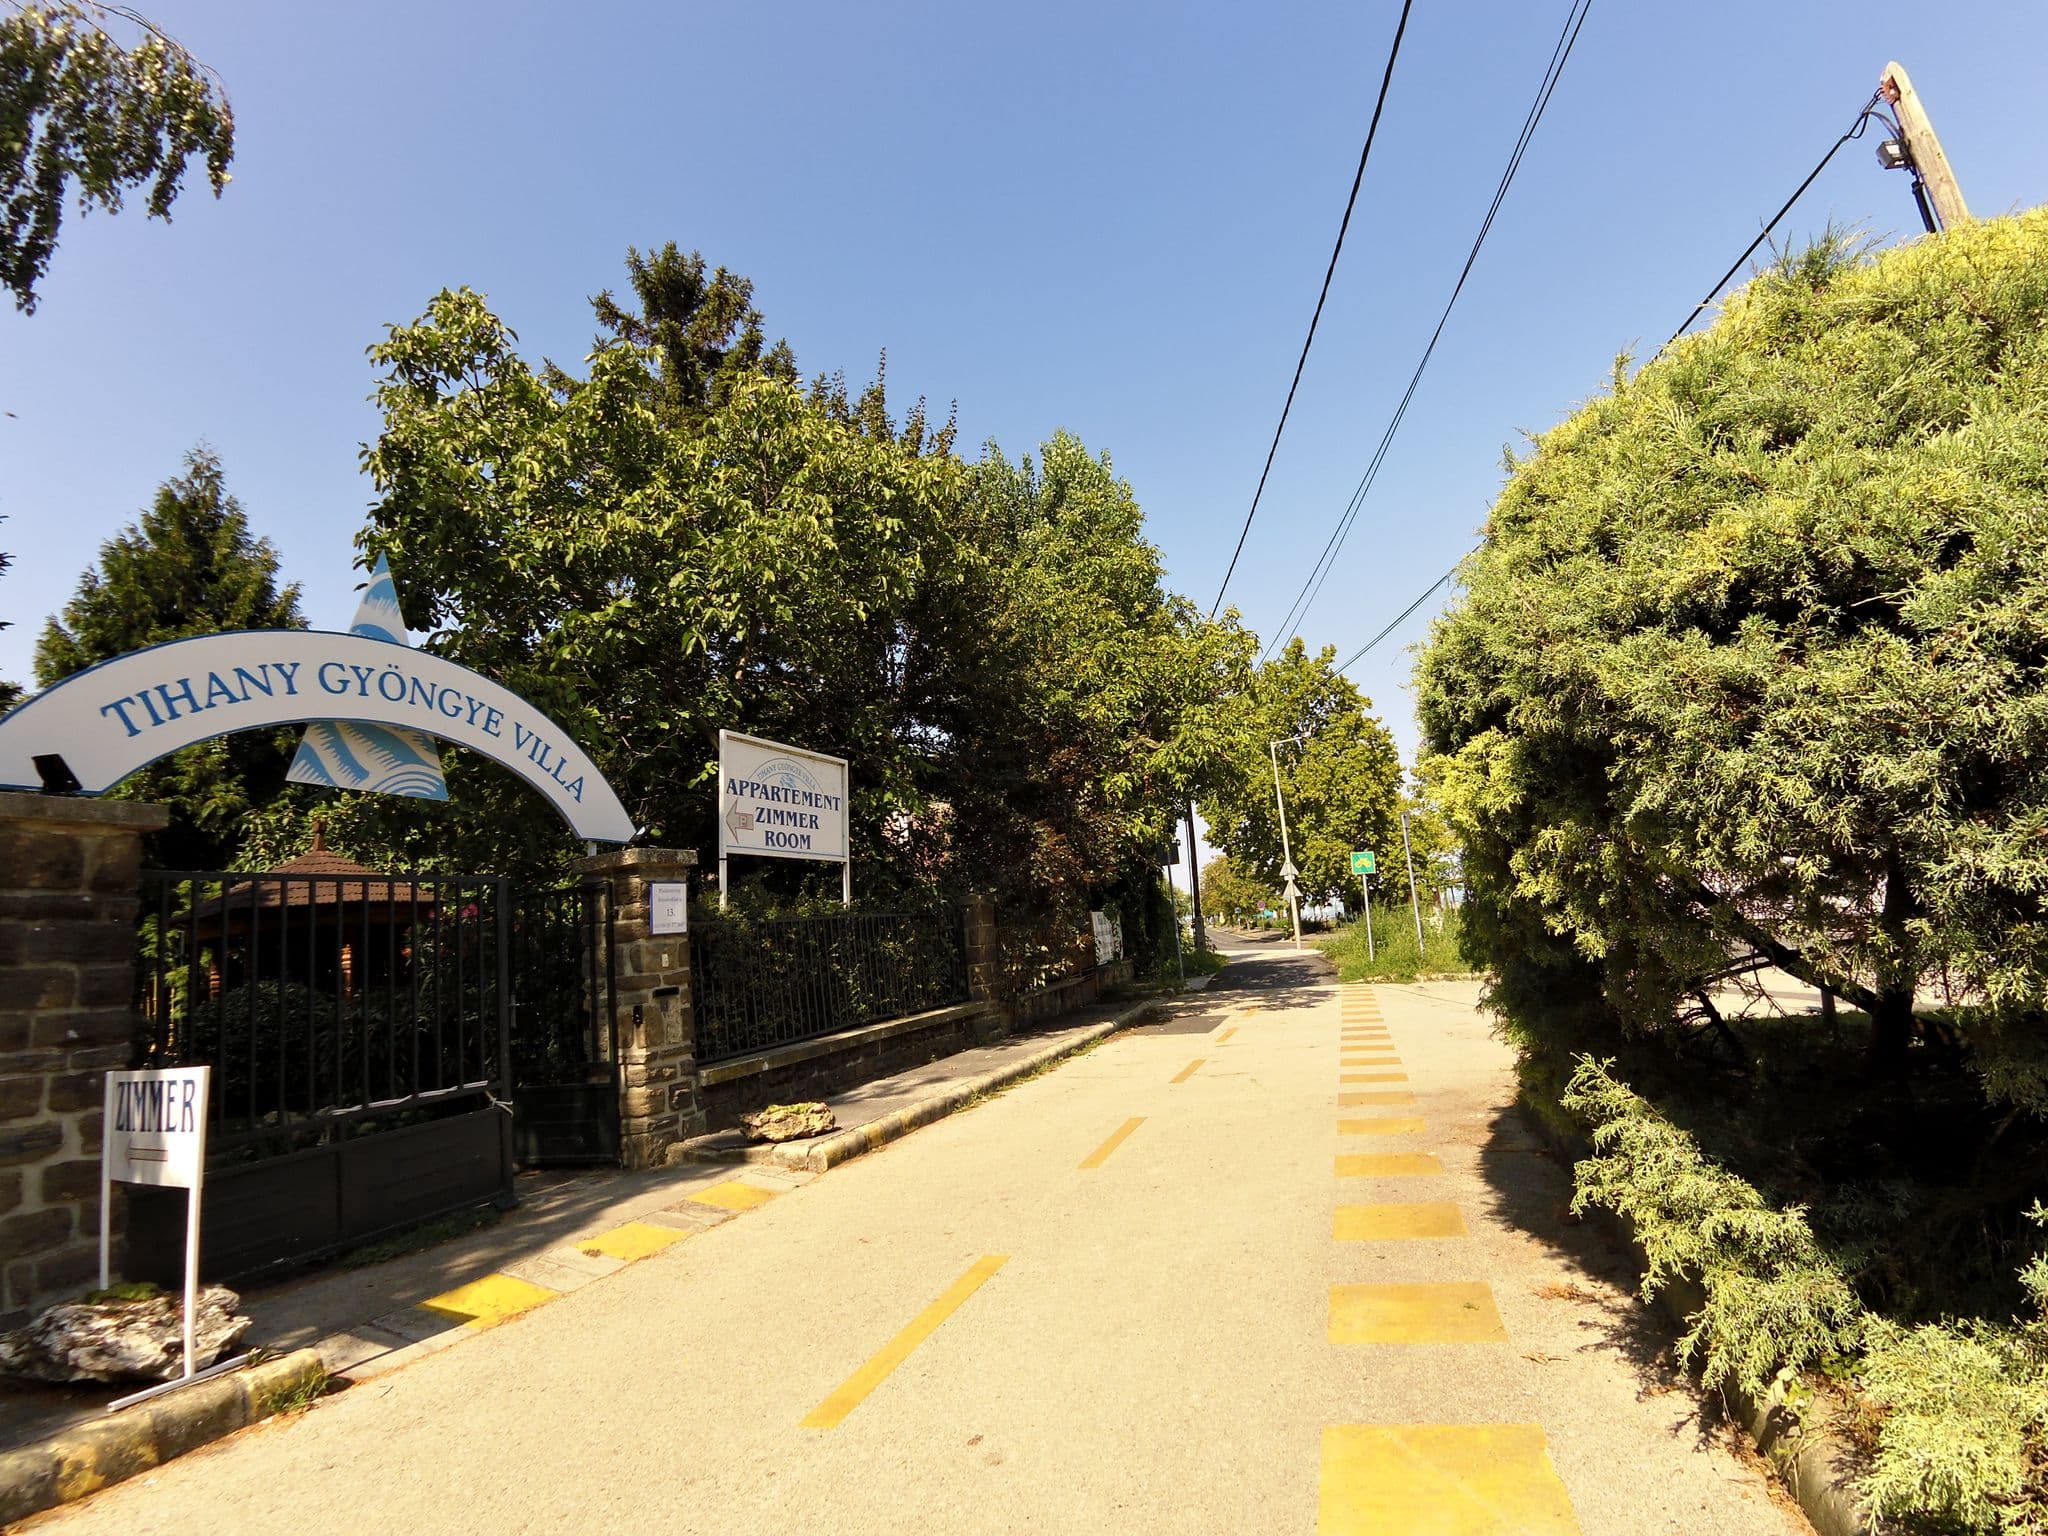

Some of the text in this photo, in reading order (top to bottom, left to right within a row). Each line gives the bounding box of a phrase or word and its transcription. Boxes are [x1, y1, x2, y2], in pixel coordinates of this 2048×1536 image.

[101, 662, 588, 804] TIHANY GYÖNGYE VILLA
[726, 778, 841, 811] APPARTEMENT
[755, 806, 819, 830] ZIMMER
[765, 830, 811, 850] ROOM
[115, 1079, 196, 1133] ZIMMER
